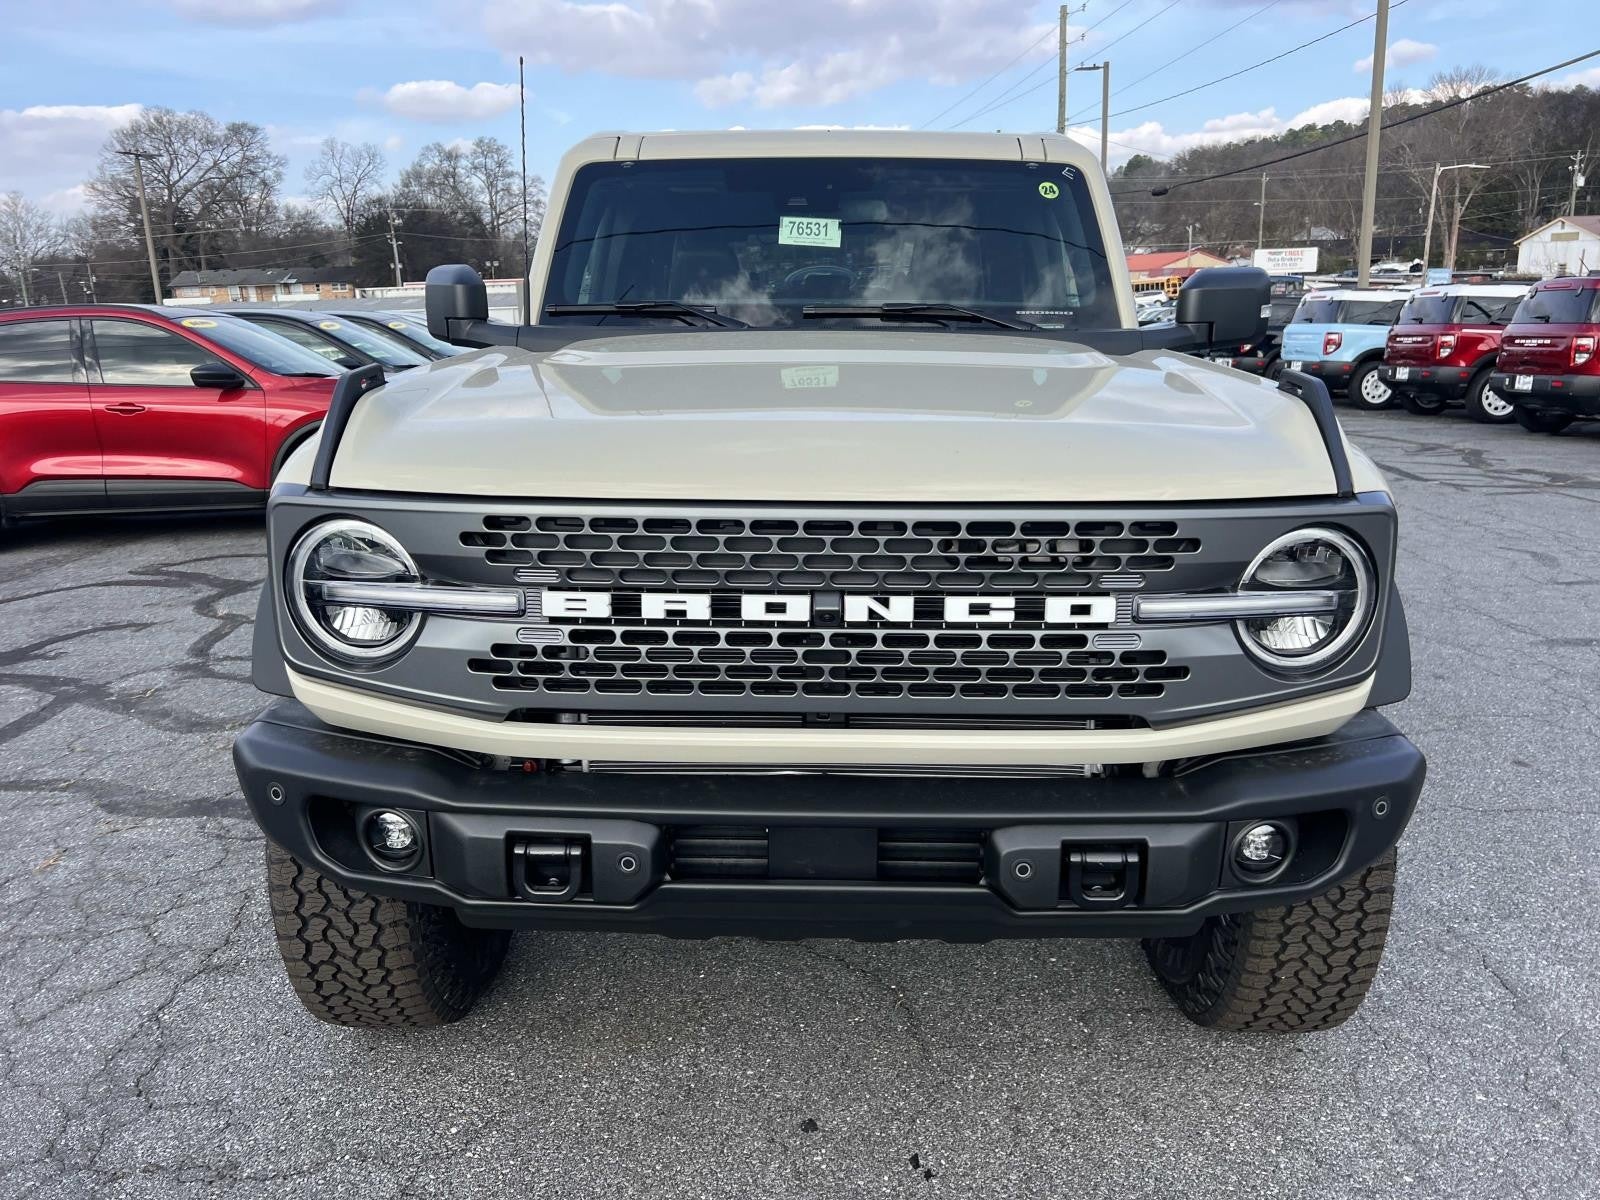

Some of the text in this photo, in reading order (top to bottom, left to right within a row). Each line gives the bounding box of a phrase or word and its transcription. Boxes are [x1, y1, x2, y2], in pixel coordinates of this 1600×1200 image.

[1041, 185, 1056, 195] 24
[788, 221, 828, 237] 76531
[541, 590, 1117, 623] BRONCO
